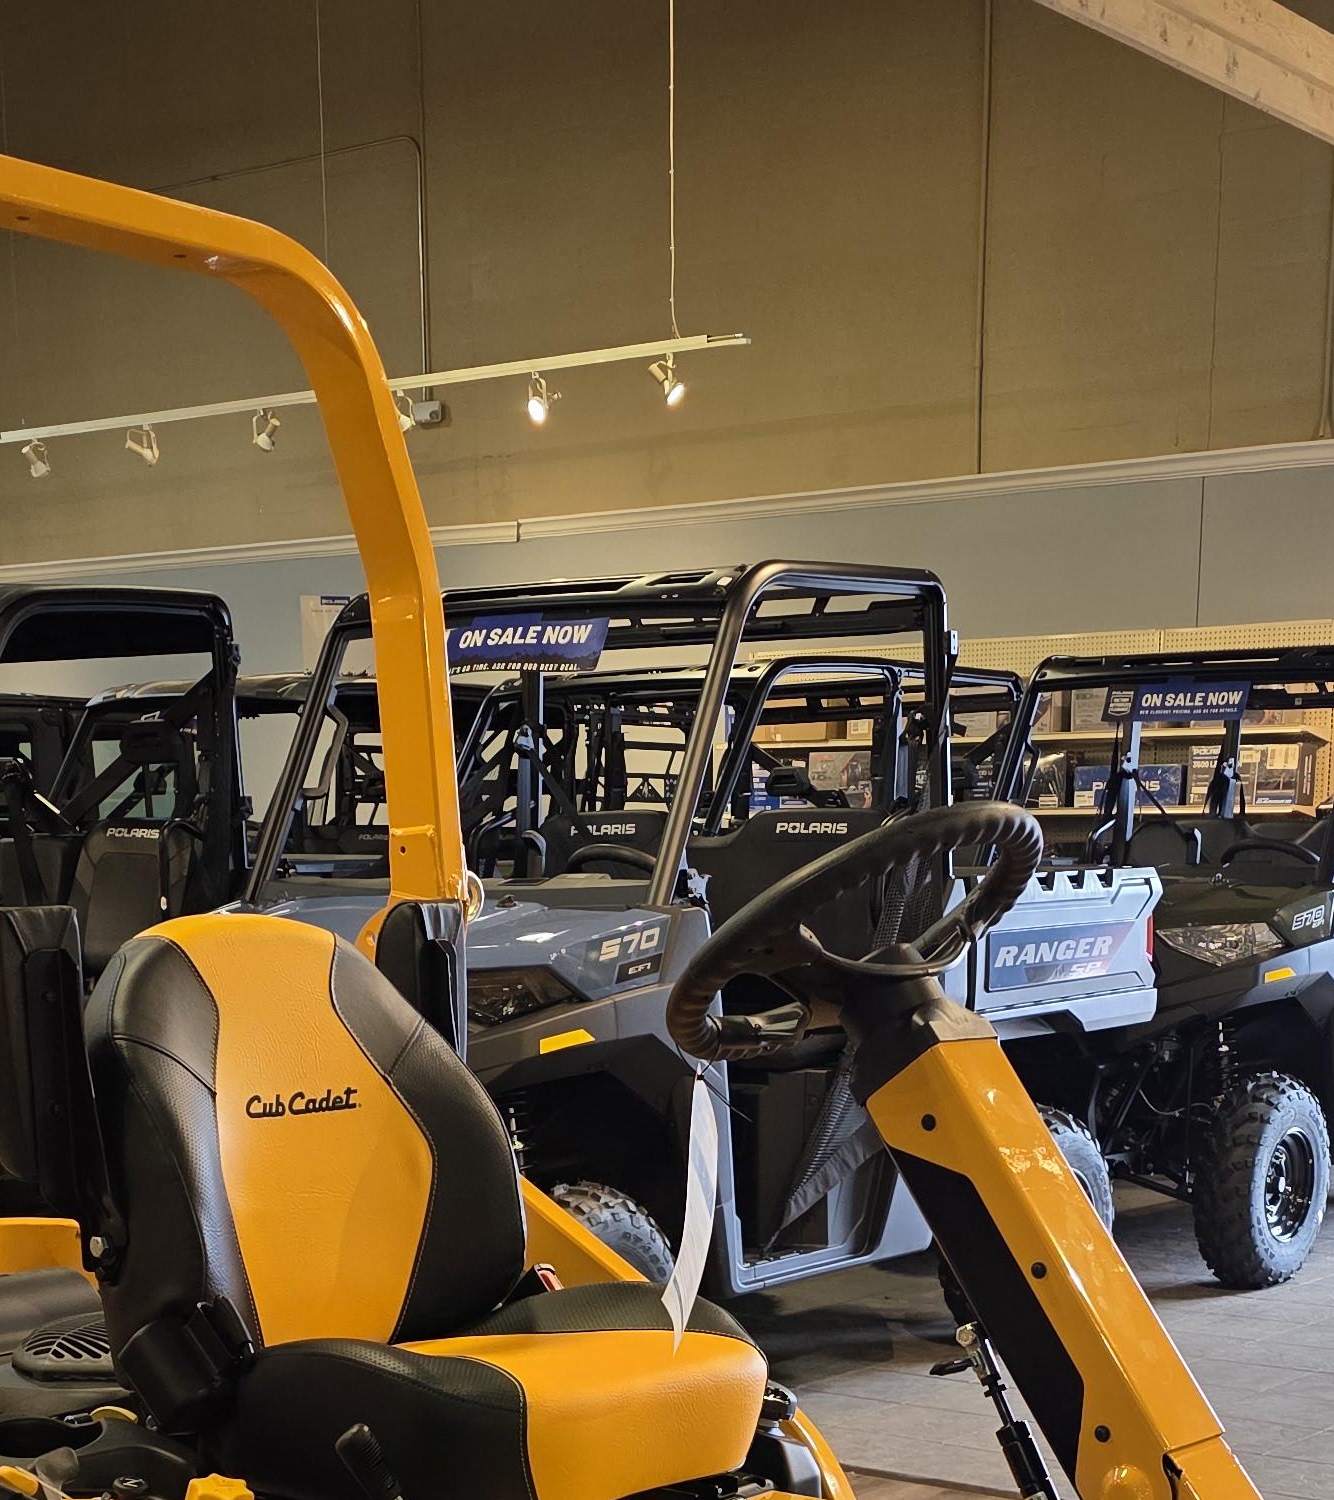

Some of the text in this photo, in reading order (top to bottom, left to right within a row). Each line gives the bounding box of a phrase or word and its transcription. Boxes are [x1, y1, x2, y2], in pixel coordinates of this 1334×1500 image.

[458, 623, 593, 649] ON SALE NOW
[1141, 693, 1164, 707] ON
[1164, 692, 1206, 706] SALE
[1206, 690, 1244, 706] NOW
[105, 826, 161, 839] POLARIS
[570, 823, 636, 837] PLARIS
[775, 821, 848, 834] POLARIS
[1292, 905, 1325, 931] 570
[598, 926, 662, 962] 570
[994, 933, 1114, 969] RANGER
[1069, 961, 1104, 976] SP
[246, 1086, 360, 1119] Cub Cadet
